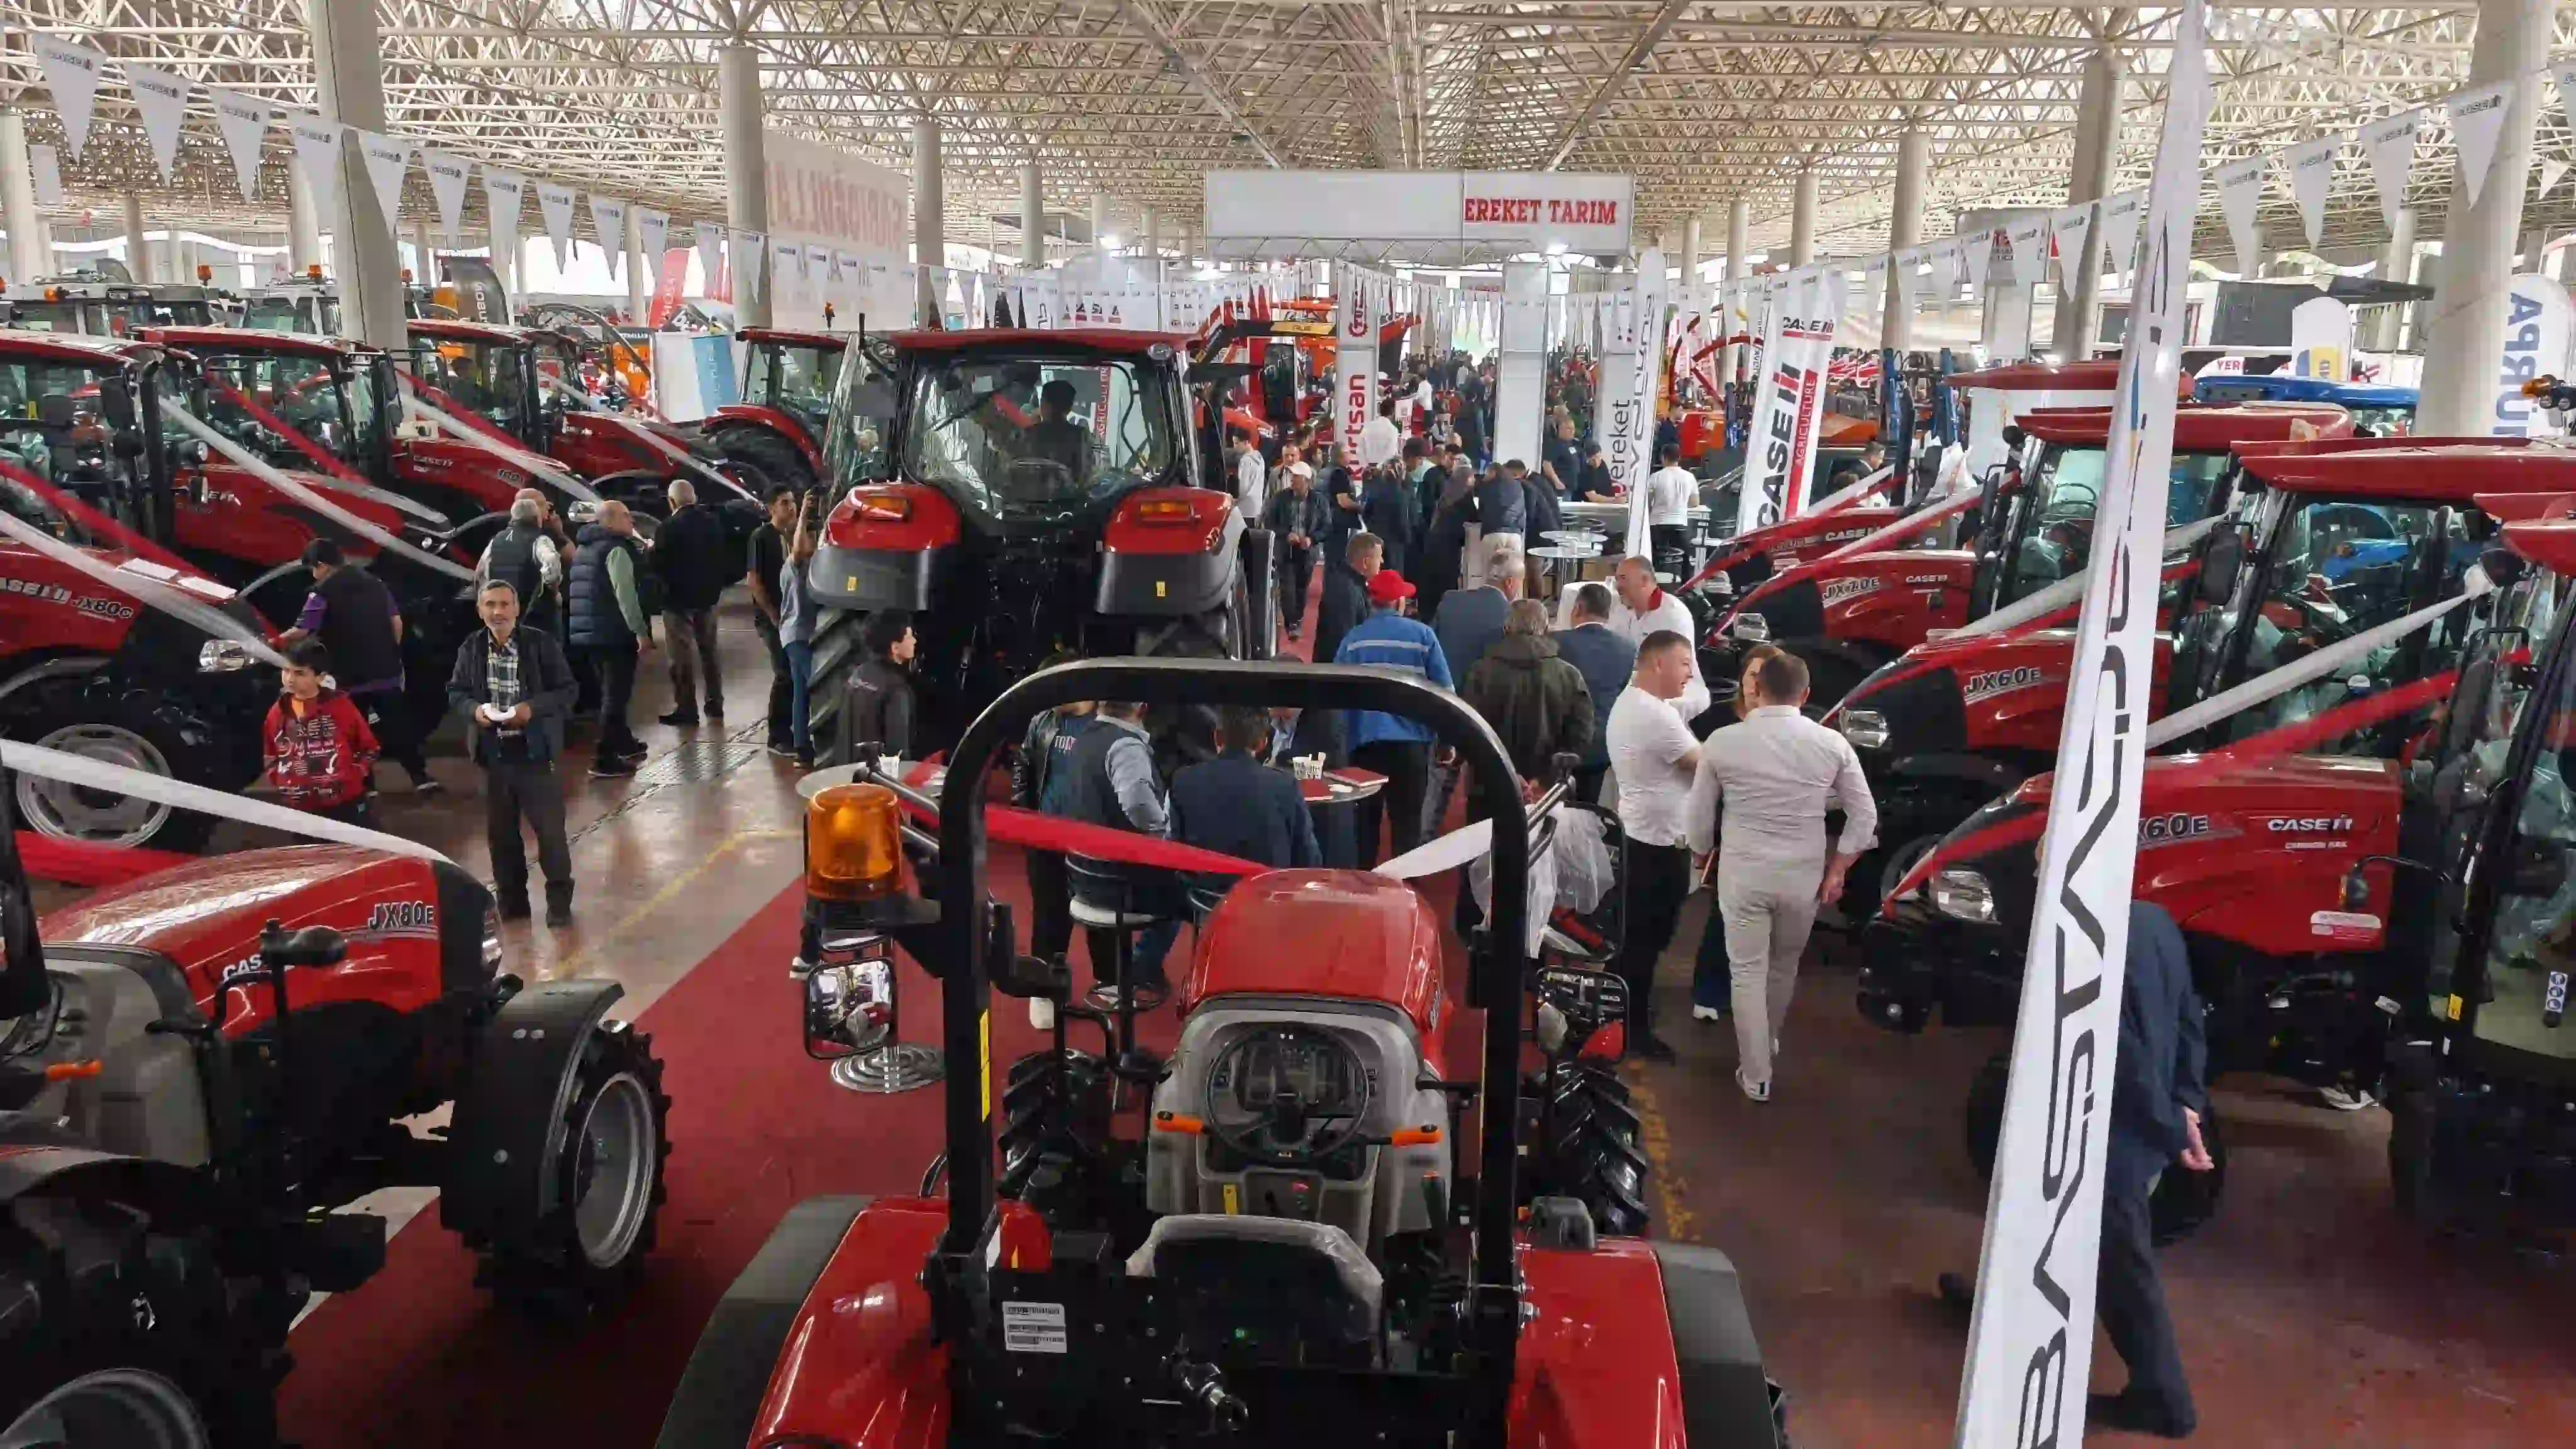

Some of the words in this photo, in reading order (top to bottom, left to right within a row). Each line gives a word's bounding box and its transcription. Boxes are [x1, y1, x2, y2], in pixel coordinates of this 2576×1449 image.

[1464, 197, 1541, 223] EREKET
[1548, 199, 1618, 225] TARIM
[1794, 375, 1818, 466] AGRICULTURE
[1757, 409, 1794, 526] CASE
[0, 577, 40, 596] ASE
[1963, 666, 2041, 695] JX60E
[2138, 813, 2209, 841] 60E
[2268, 818, 2331, 831] CASE
[367, 900, 435, 931] JX80E
